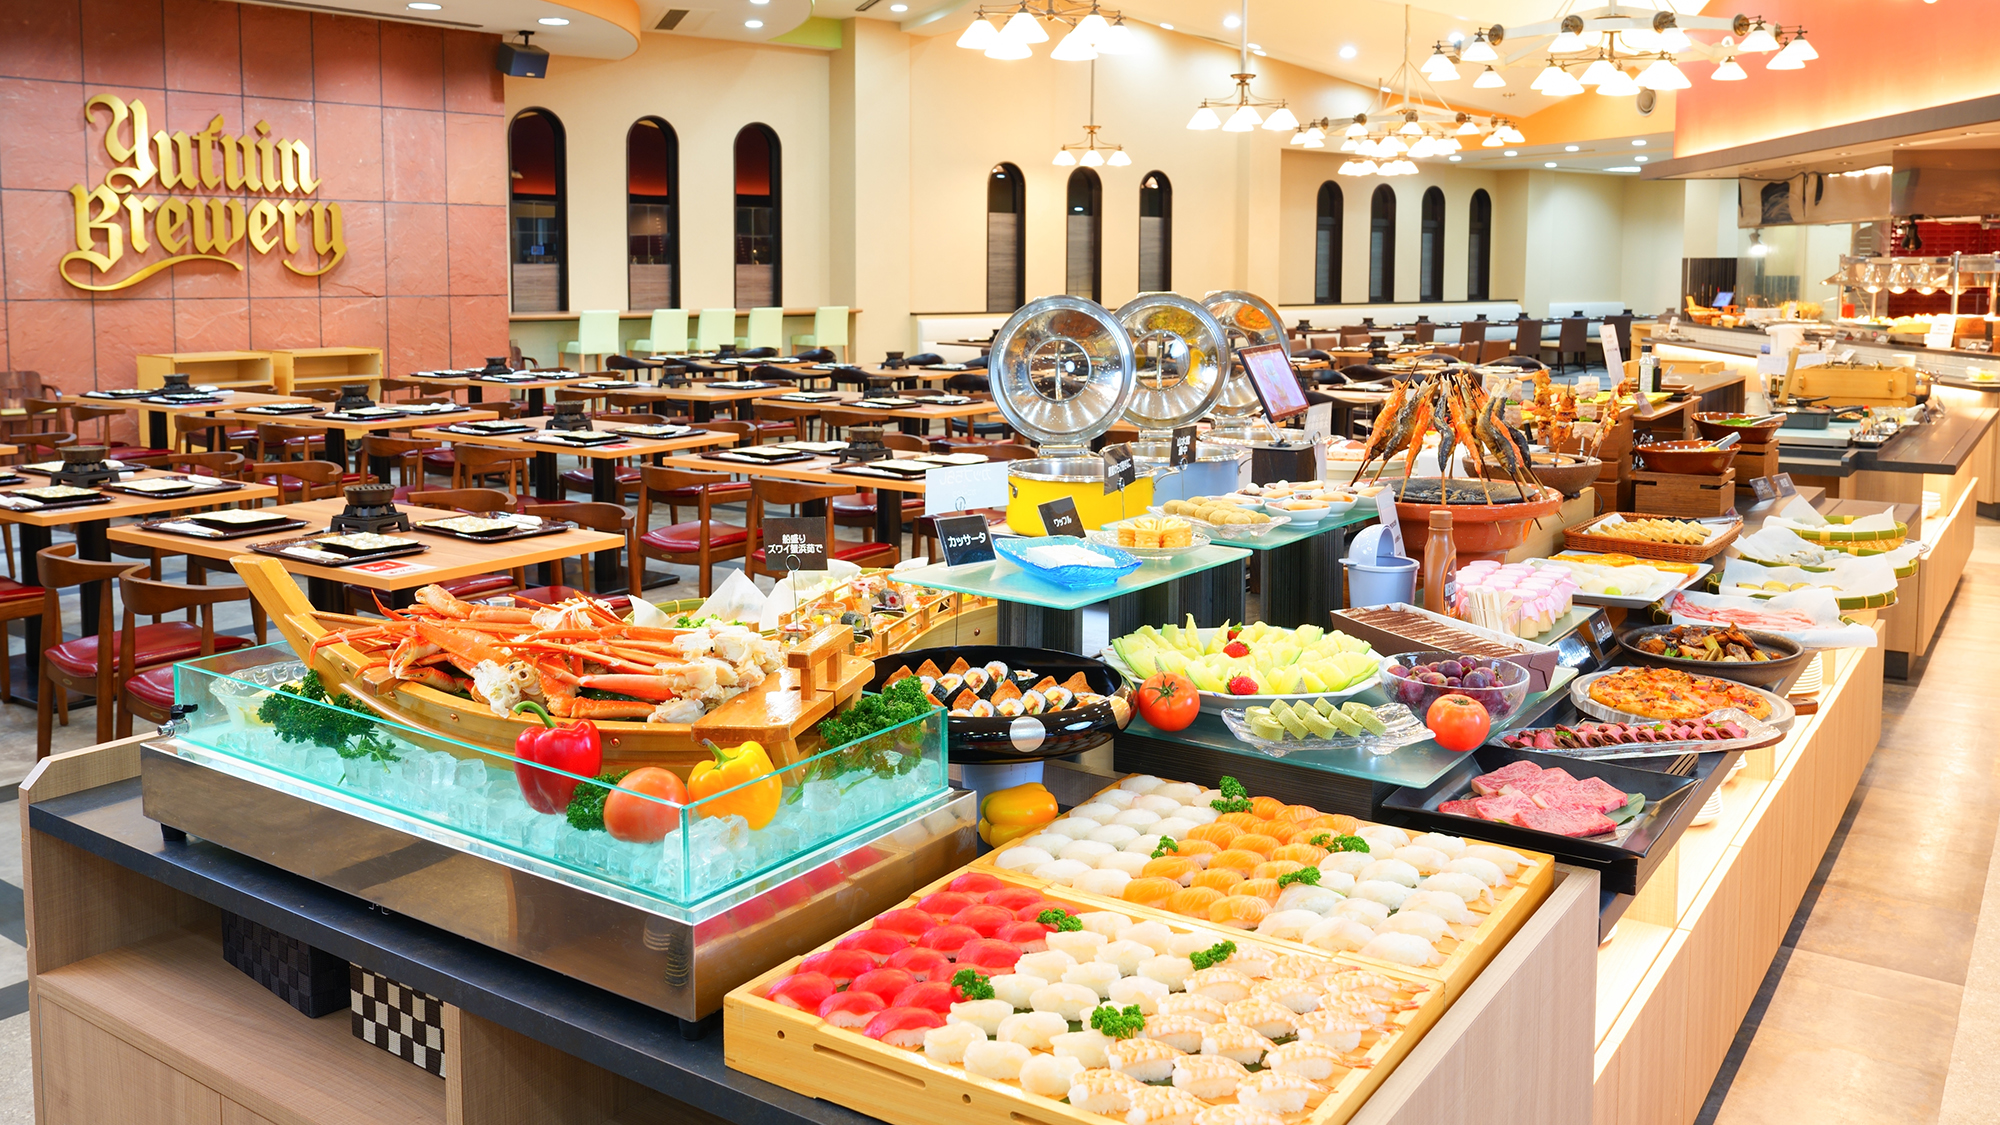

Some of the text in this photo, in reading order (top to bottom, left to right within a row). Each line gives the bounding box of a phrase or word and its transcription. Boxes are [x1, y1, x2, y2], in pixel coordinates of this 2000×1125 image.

[59, 183, 348, 291] Brewery
[1053, 515, 1072, 527] ワッフル
[947, 531, 986, 548] カッサータ
